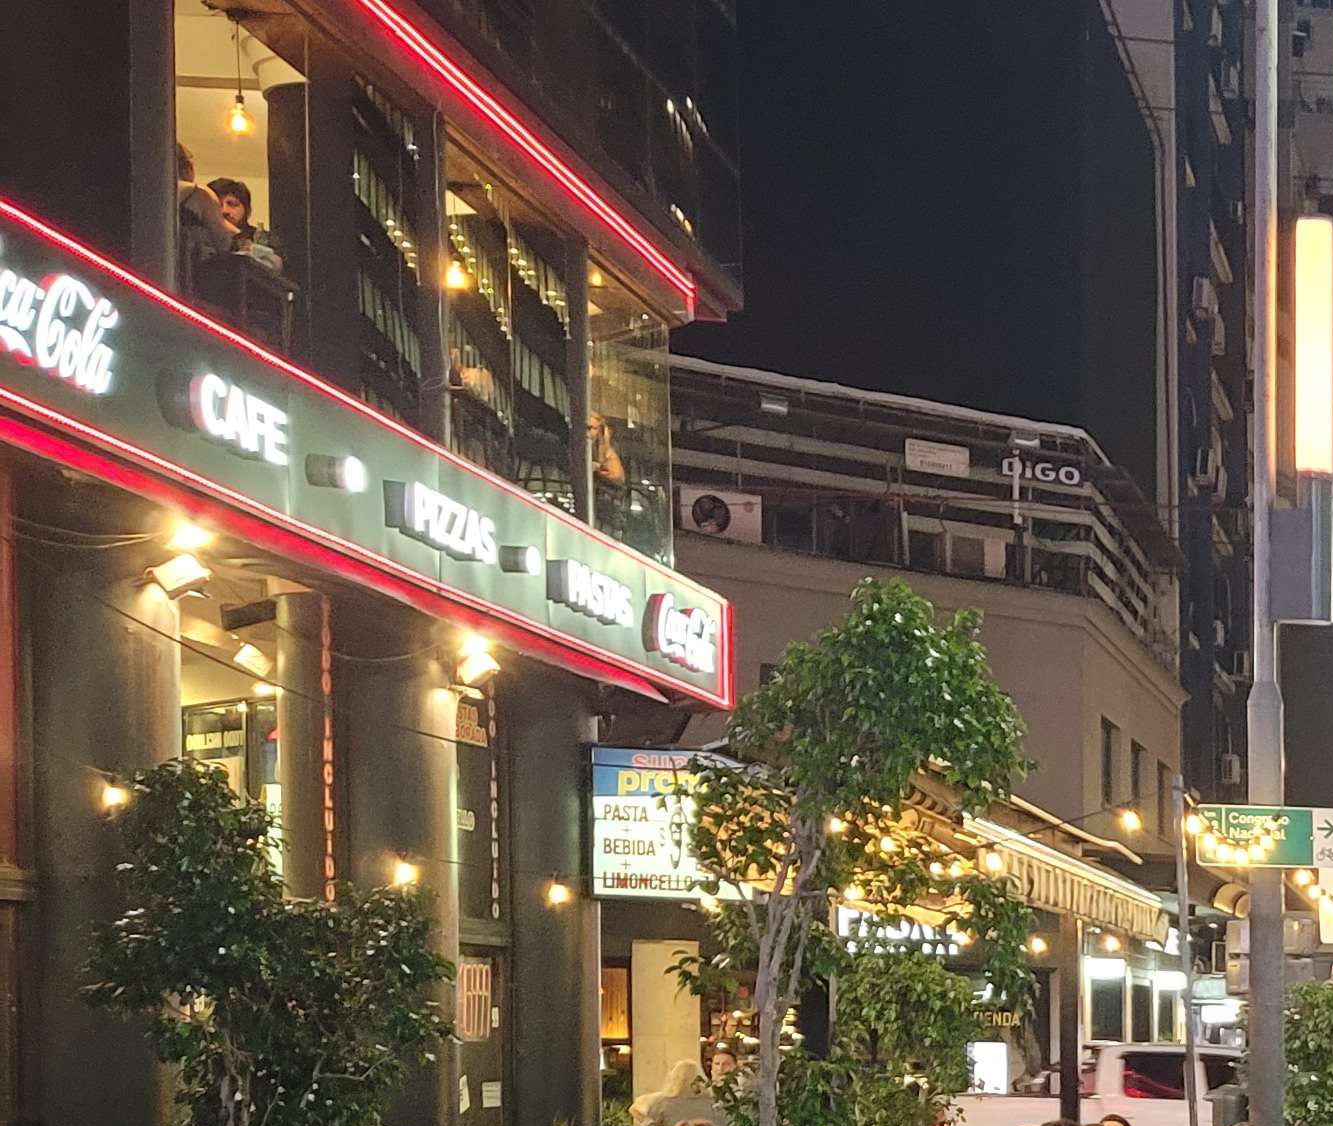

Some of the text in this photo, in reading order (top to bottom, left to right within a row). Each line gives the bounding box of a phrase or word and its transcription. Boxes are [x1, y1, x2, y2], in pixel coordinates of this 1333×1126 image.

[200, 373, 289, 466] CAFE
[413, 480, 497, 565] PIZZAS
[567, 558, 633, 629] PASTAS
[603, 803, 649, 822] PASTA
[602, 838, 656, 857] BEBIDA
[602, 871, 694, 891] LIMONCELLO
